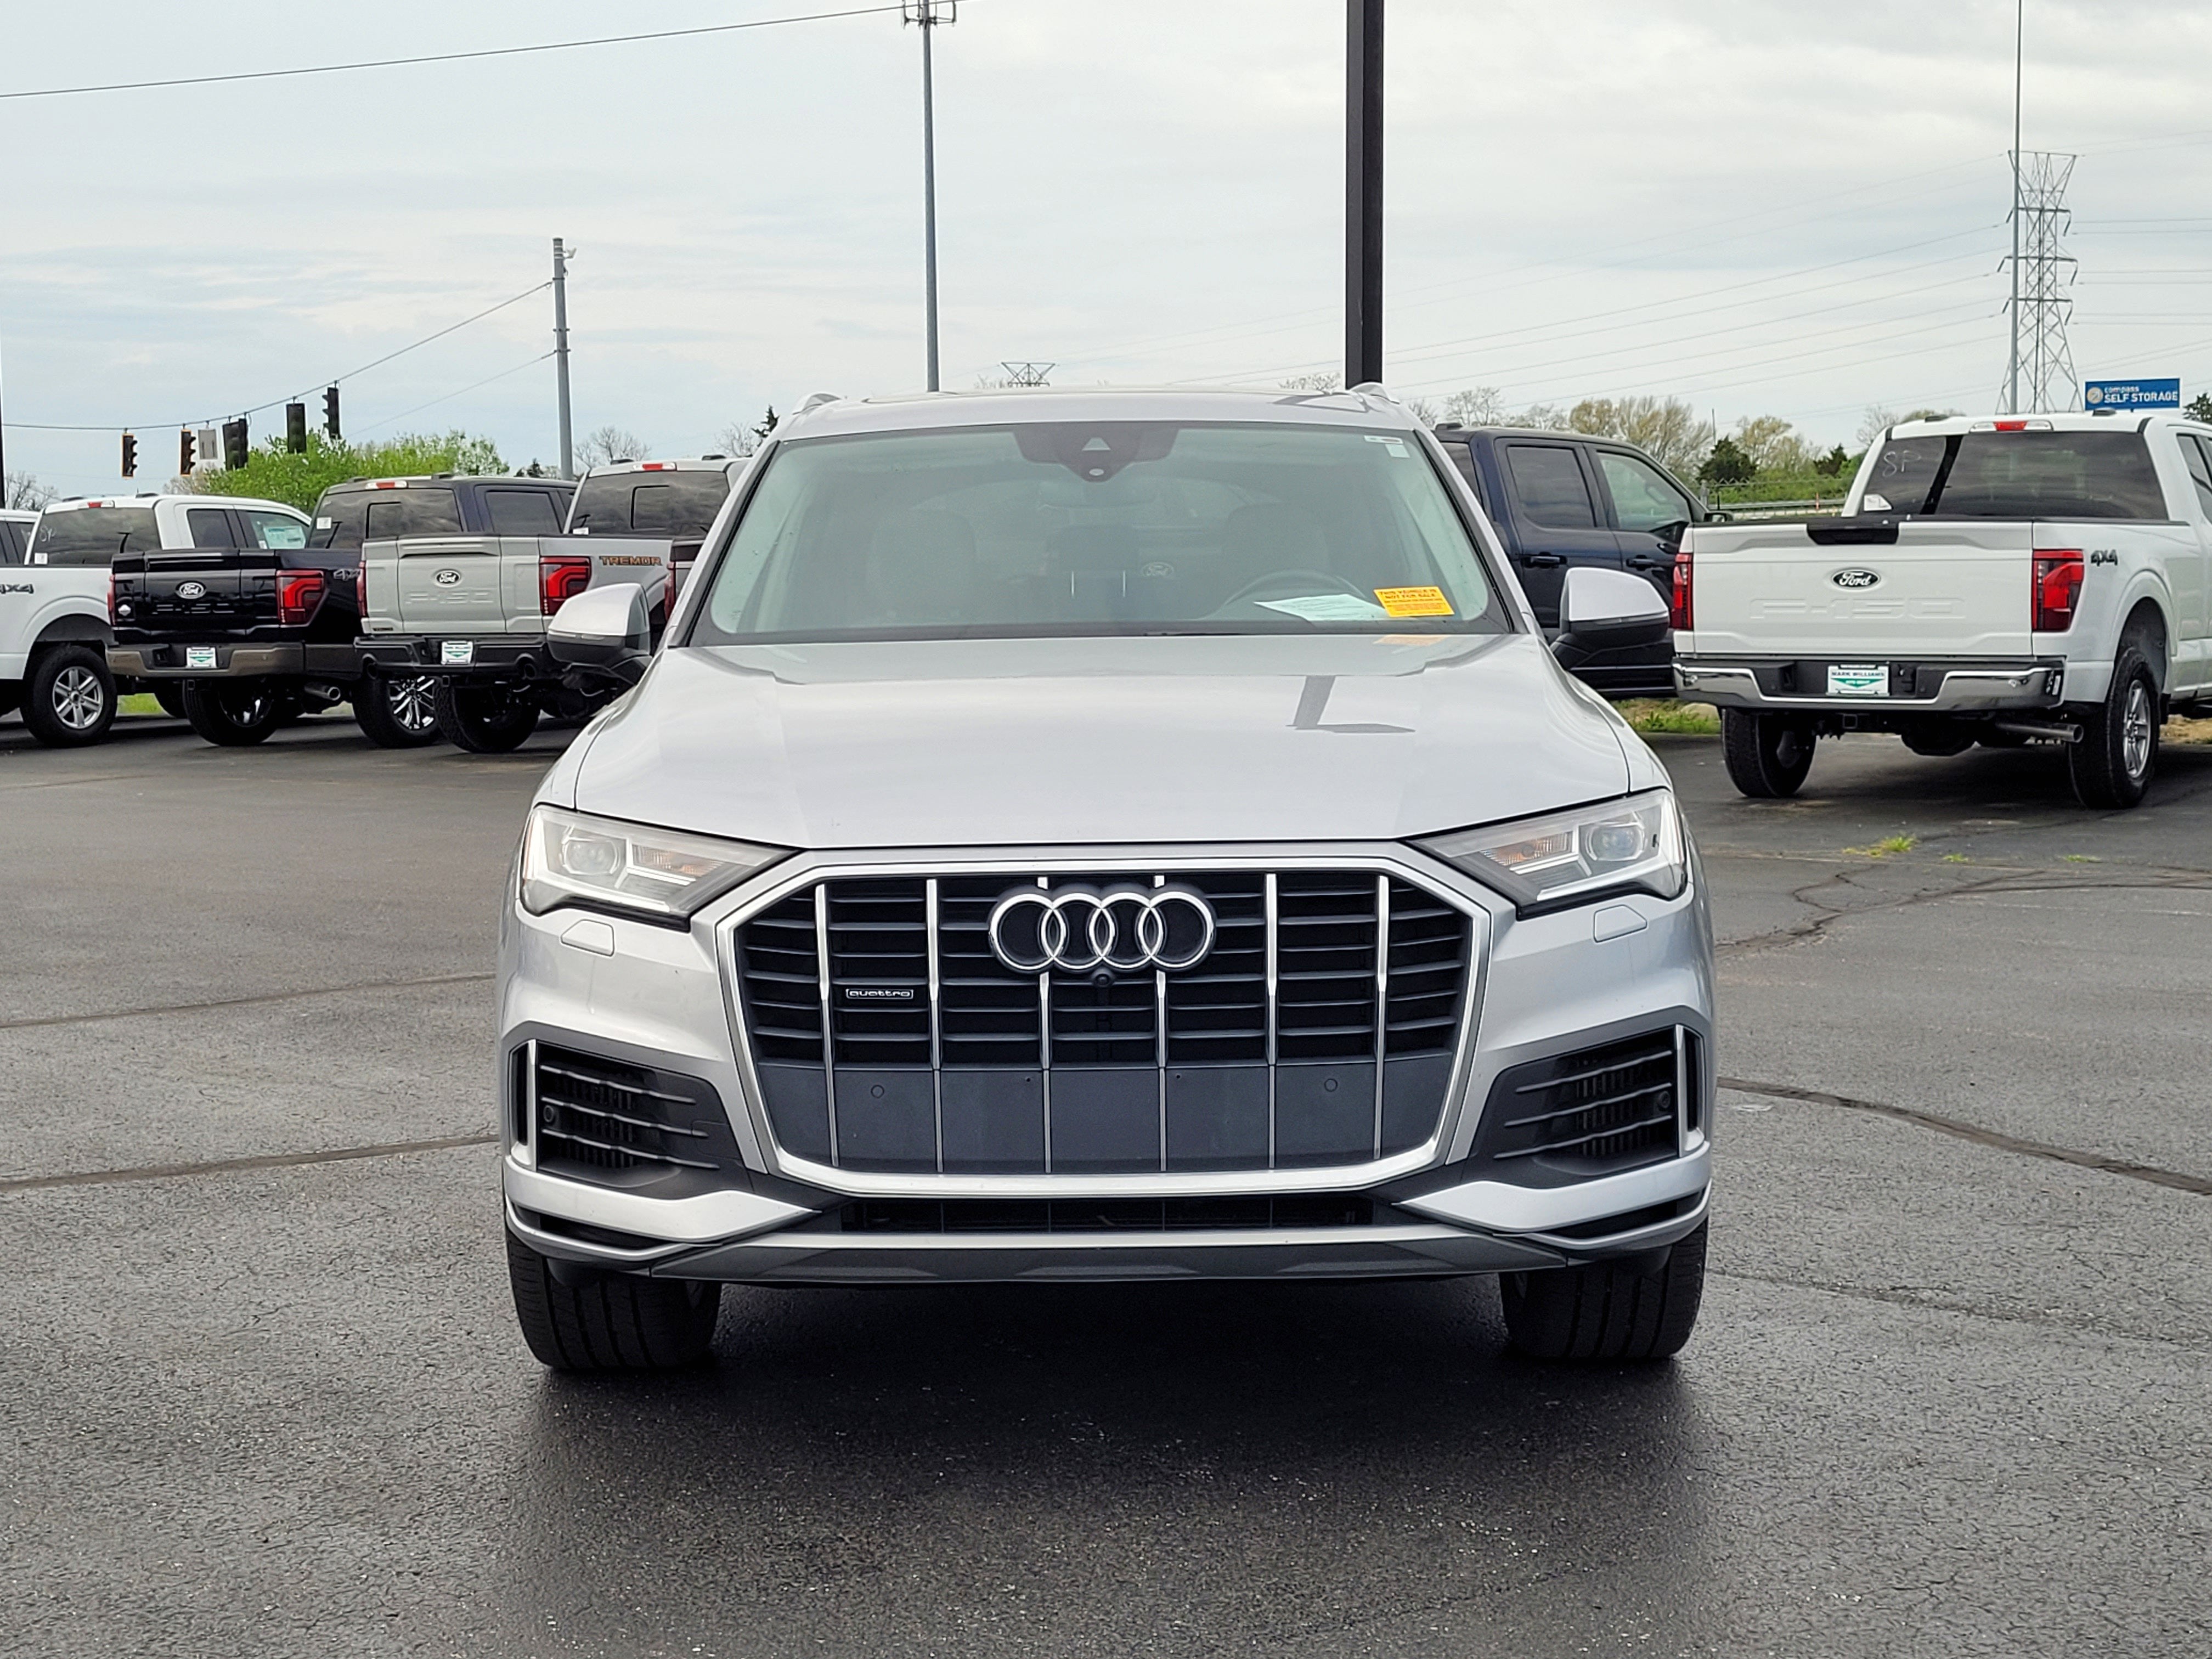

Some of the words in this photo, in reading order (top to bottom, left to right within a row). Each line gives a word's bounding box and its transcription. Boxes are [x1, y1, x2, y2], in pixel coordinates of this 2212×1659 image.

[2104, 394, 2129, 403] SELF
[2131, 392, 2178, 402] STORAGE
[599, 556, 663, 566] TREMOR
[1839, 572, 1872, 586] Ford
[1750, 597, 1966, 619] F-150
